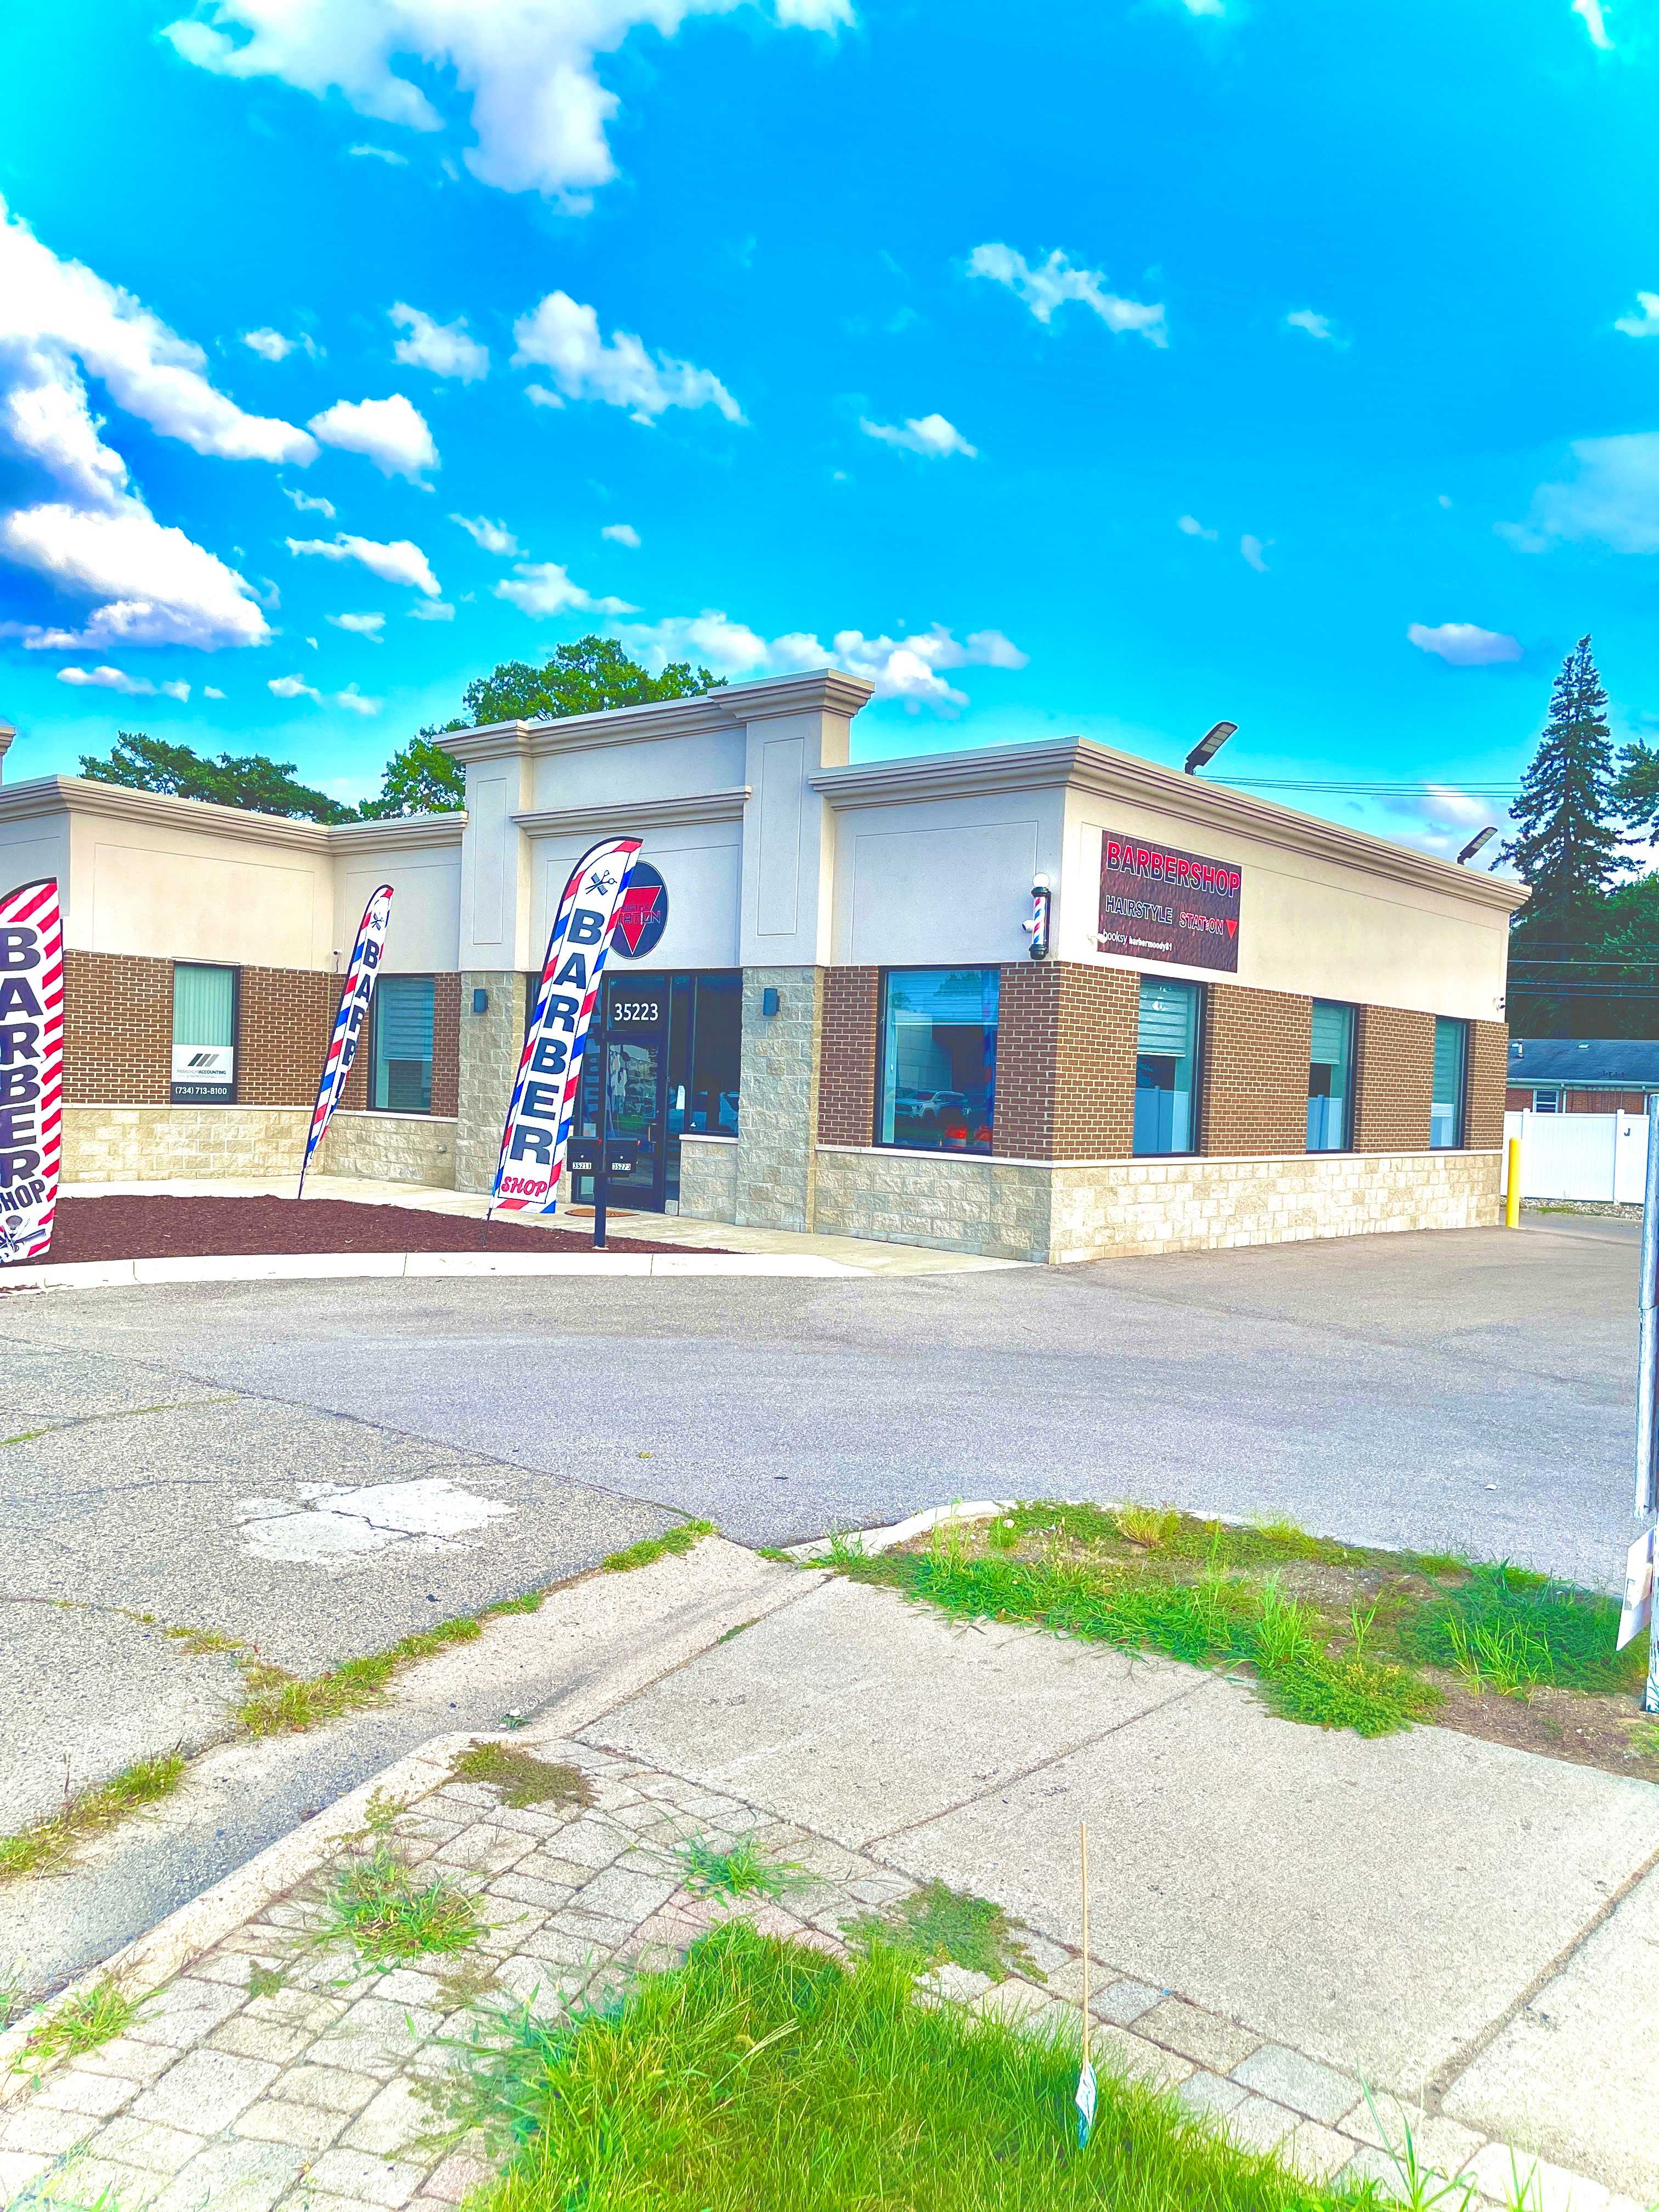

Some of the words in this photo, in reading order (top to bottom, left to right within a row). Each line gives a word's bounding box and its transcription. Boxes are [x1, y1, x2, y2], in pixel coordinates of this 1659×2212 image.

[1106, 840, 1240, 898] BARBERSHOP
[1105, 895, 1173, 924] HAIRSTYLE
[1103, 928, 1128, 945] booksy
[614, 1003, 658, 1021] 35223
[509, 908, 605, 1165] BARBER
[0, 928, 44, 1189] BARBER
[176, 1086, 194, 1094] (734)
[0, 1178, 46, 1214] HOP
[501, 1176, 548, 1197] SHOP
